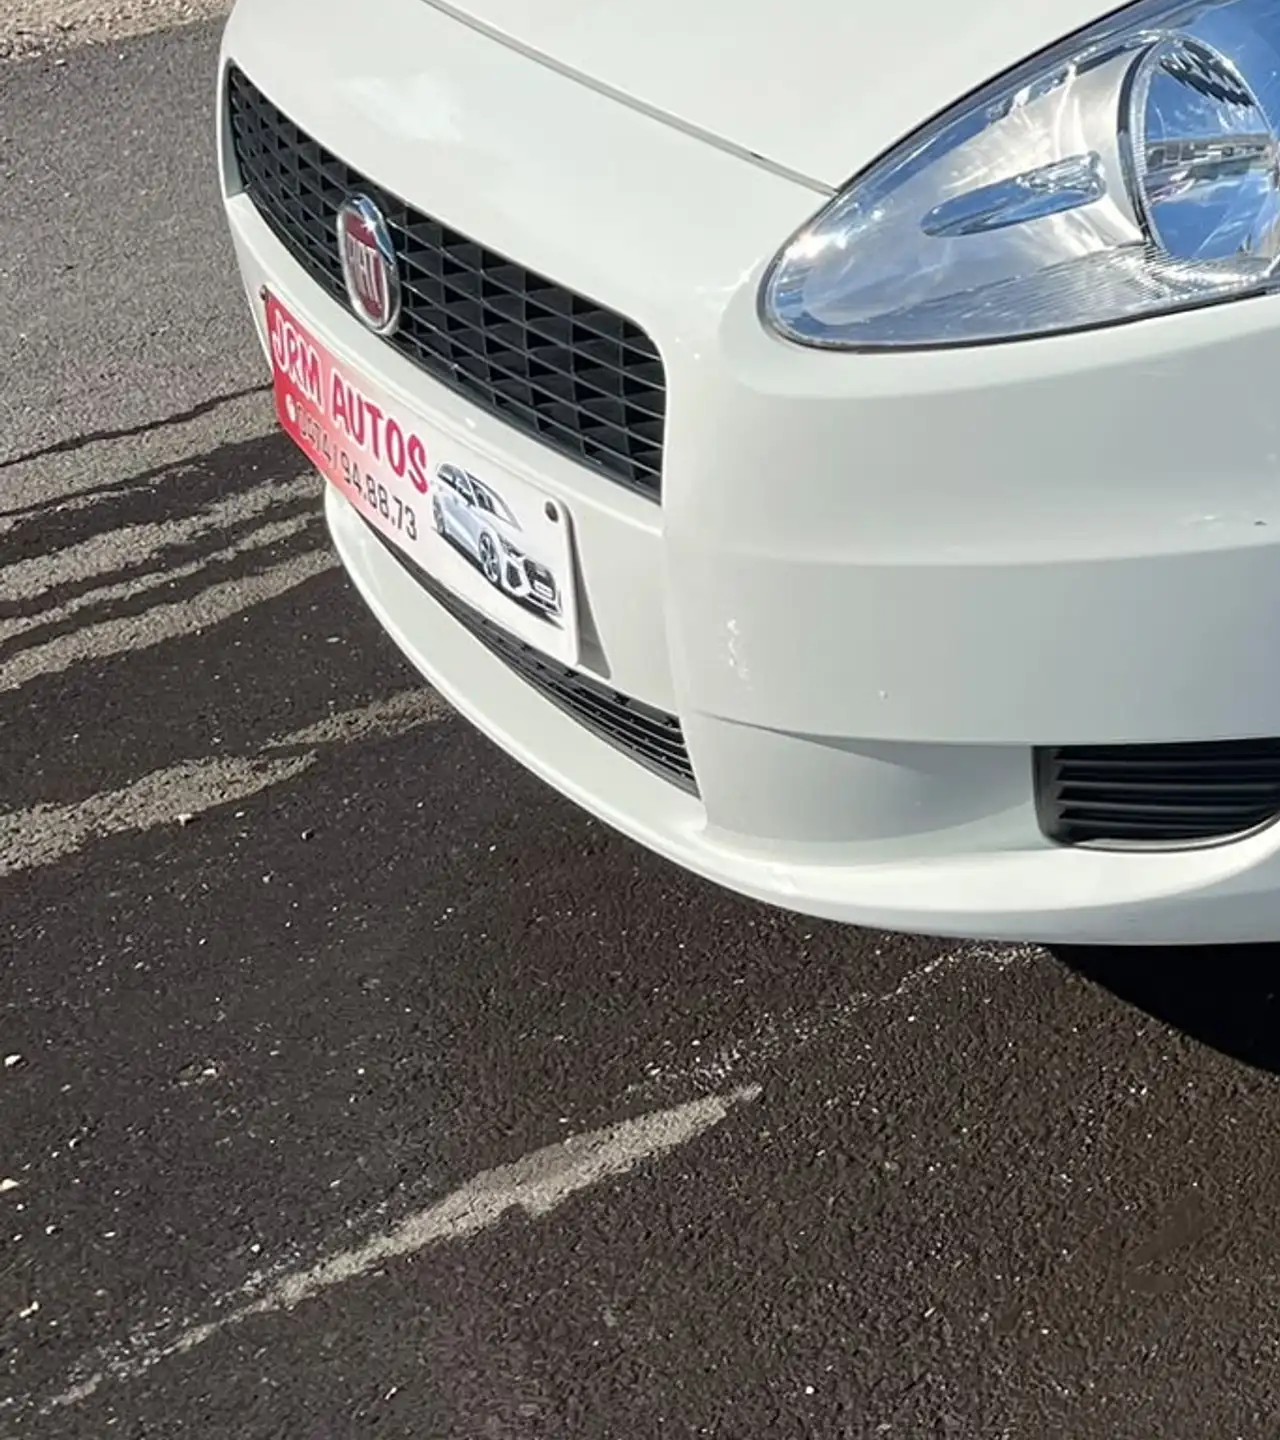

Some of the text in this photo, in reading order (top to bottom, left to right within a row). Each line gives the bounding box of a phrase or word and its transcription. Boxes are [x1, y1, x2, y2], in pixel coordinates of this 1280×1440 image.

[347, 232, 383, 309] FIAT
[272, 308, 430, 495] JRM AUTOS
